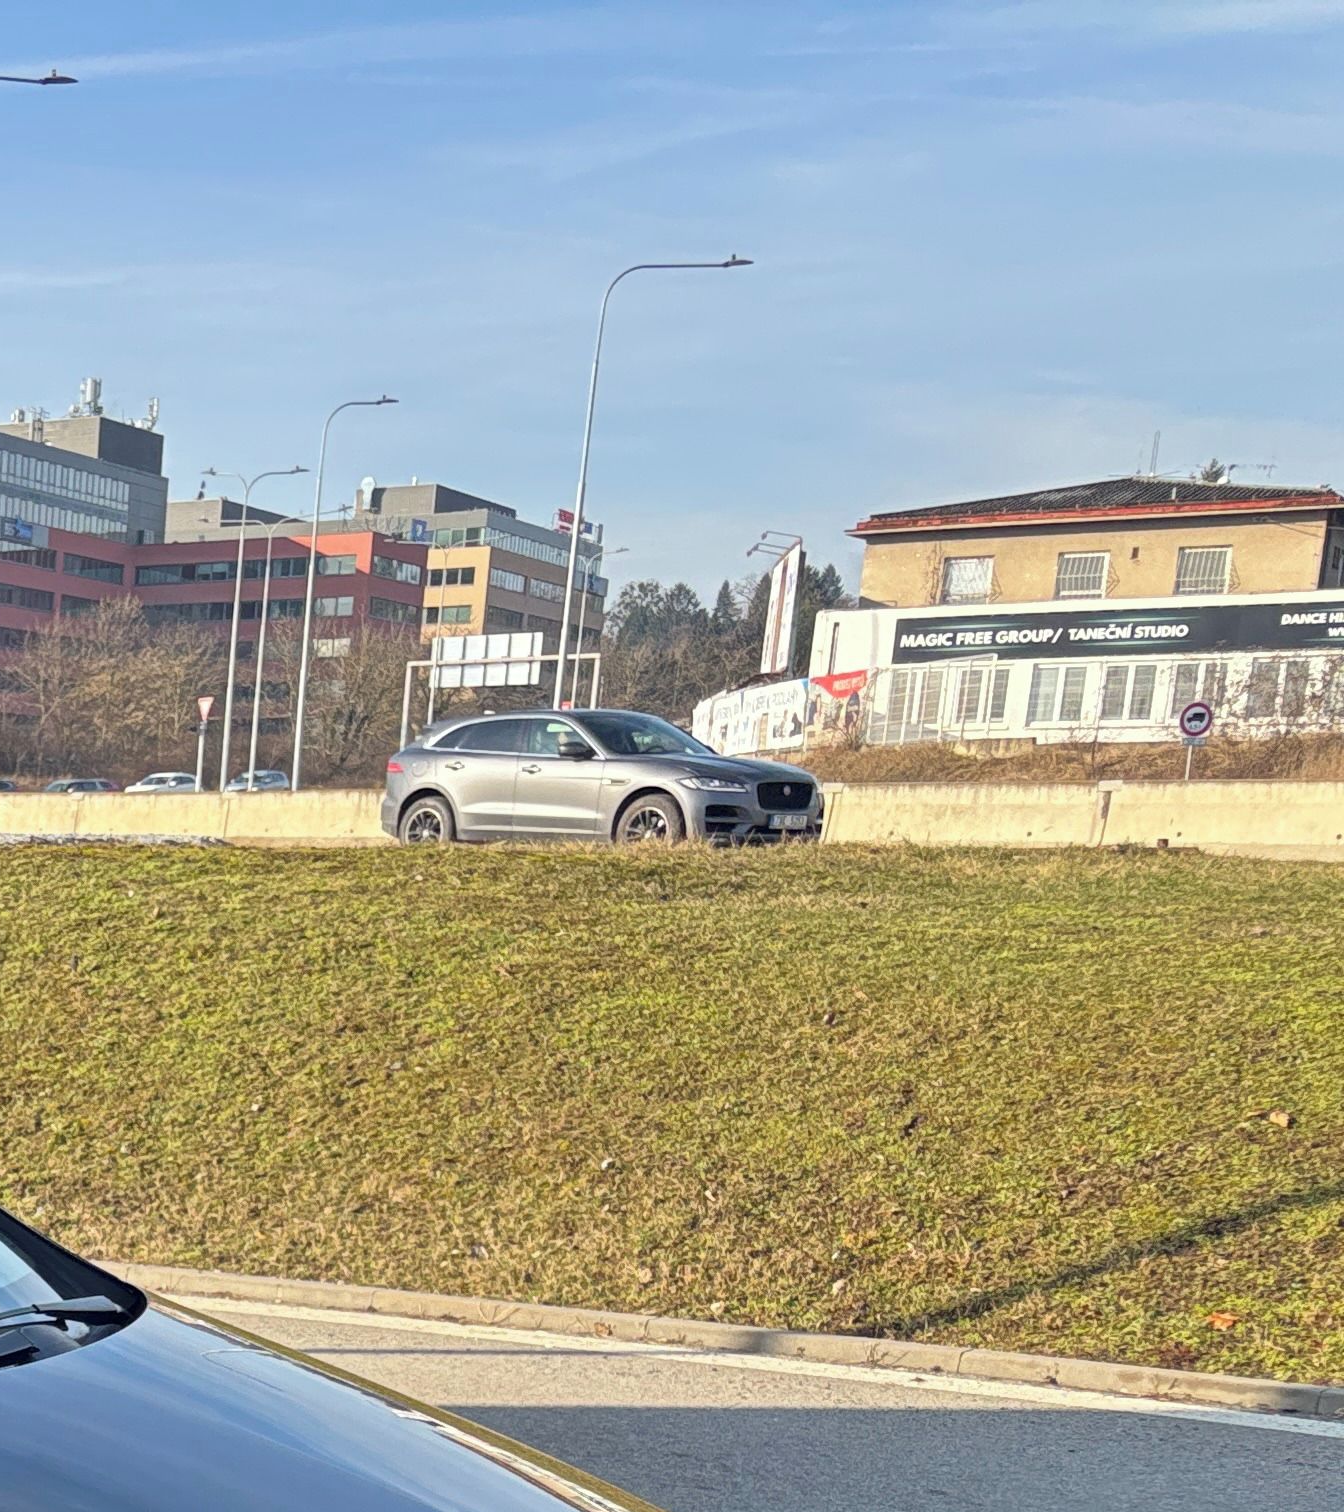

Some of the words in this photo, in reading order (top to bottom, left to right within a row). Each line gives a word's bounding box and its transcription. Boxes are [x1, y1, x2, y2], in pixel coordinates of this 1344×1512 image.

[1280, 613, 1327, 625] DANCE
[1328, 612, 1344, 624] HI
[900, 633, 953, 648] MAGIC
[955, 630, 993, 646] FREE
[1068, 623, 1132, 641] TANEČNÍ
[1134, 624, 1190, 640] STUDIO
